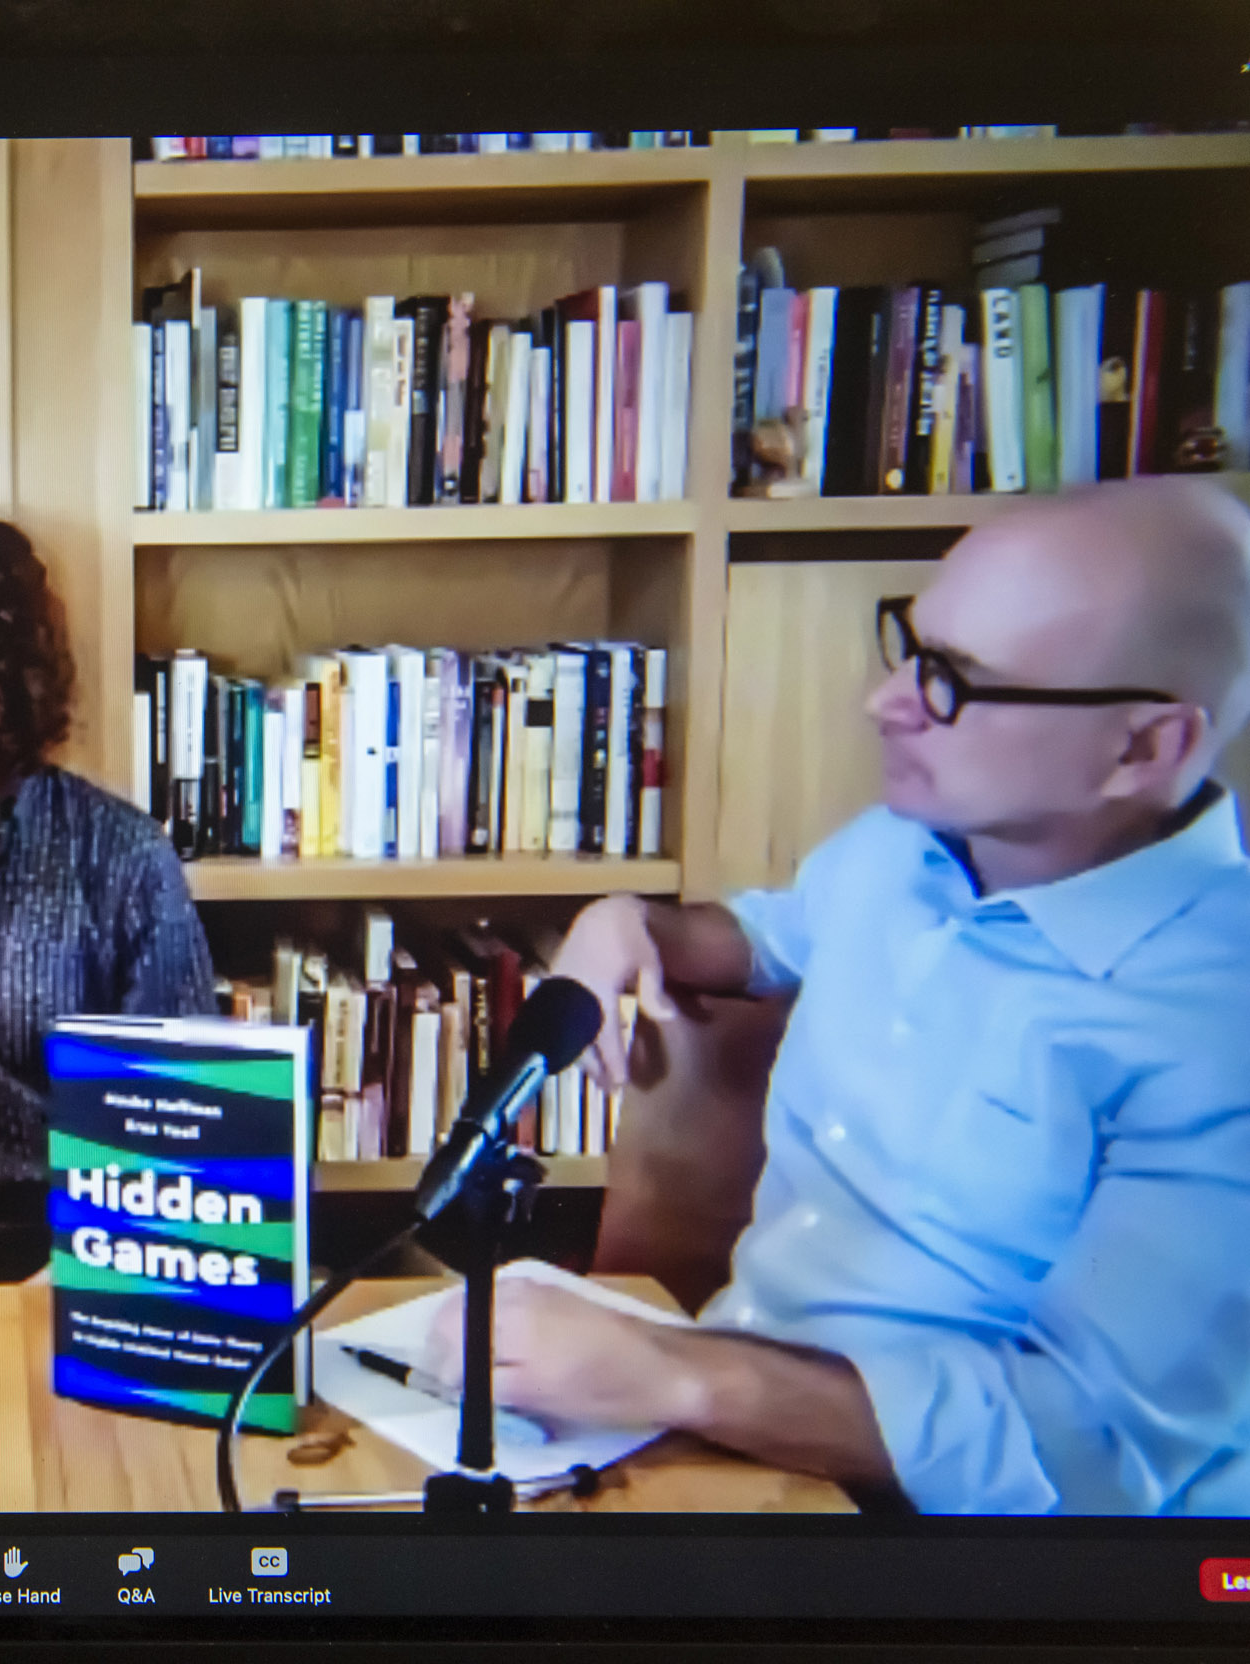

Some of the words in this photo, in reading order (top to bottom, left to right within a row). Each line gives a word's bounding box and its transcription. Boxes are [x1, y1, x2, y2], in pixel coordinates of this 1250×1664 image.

[67, 1161, 263, 1224] Hidden
[71, 1226, 259, 1286] Games
[258, 1555, 280, 1569] CC
[17, 1587, 62, 1605] Hand
[117, 1587, 156, 1606] Q&A
[208, 1587, 243, 1605] Live
[246, 1587, 332, 1608] Transcript
